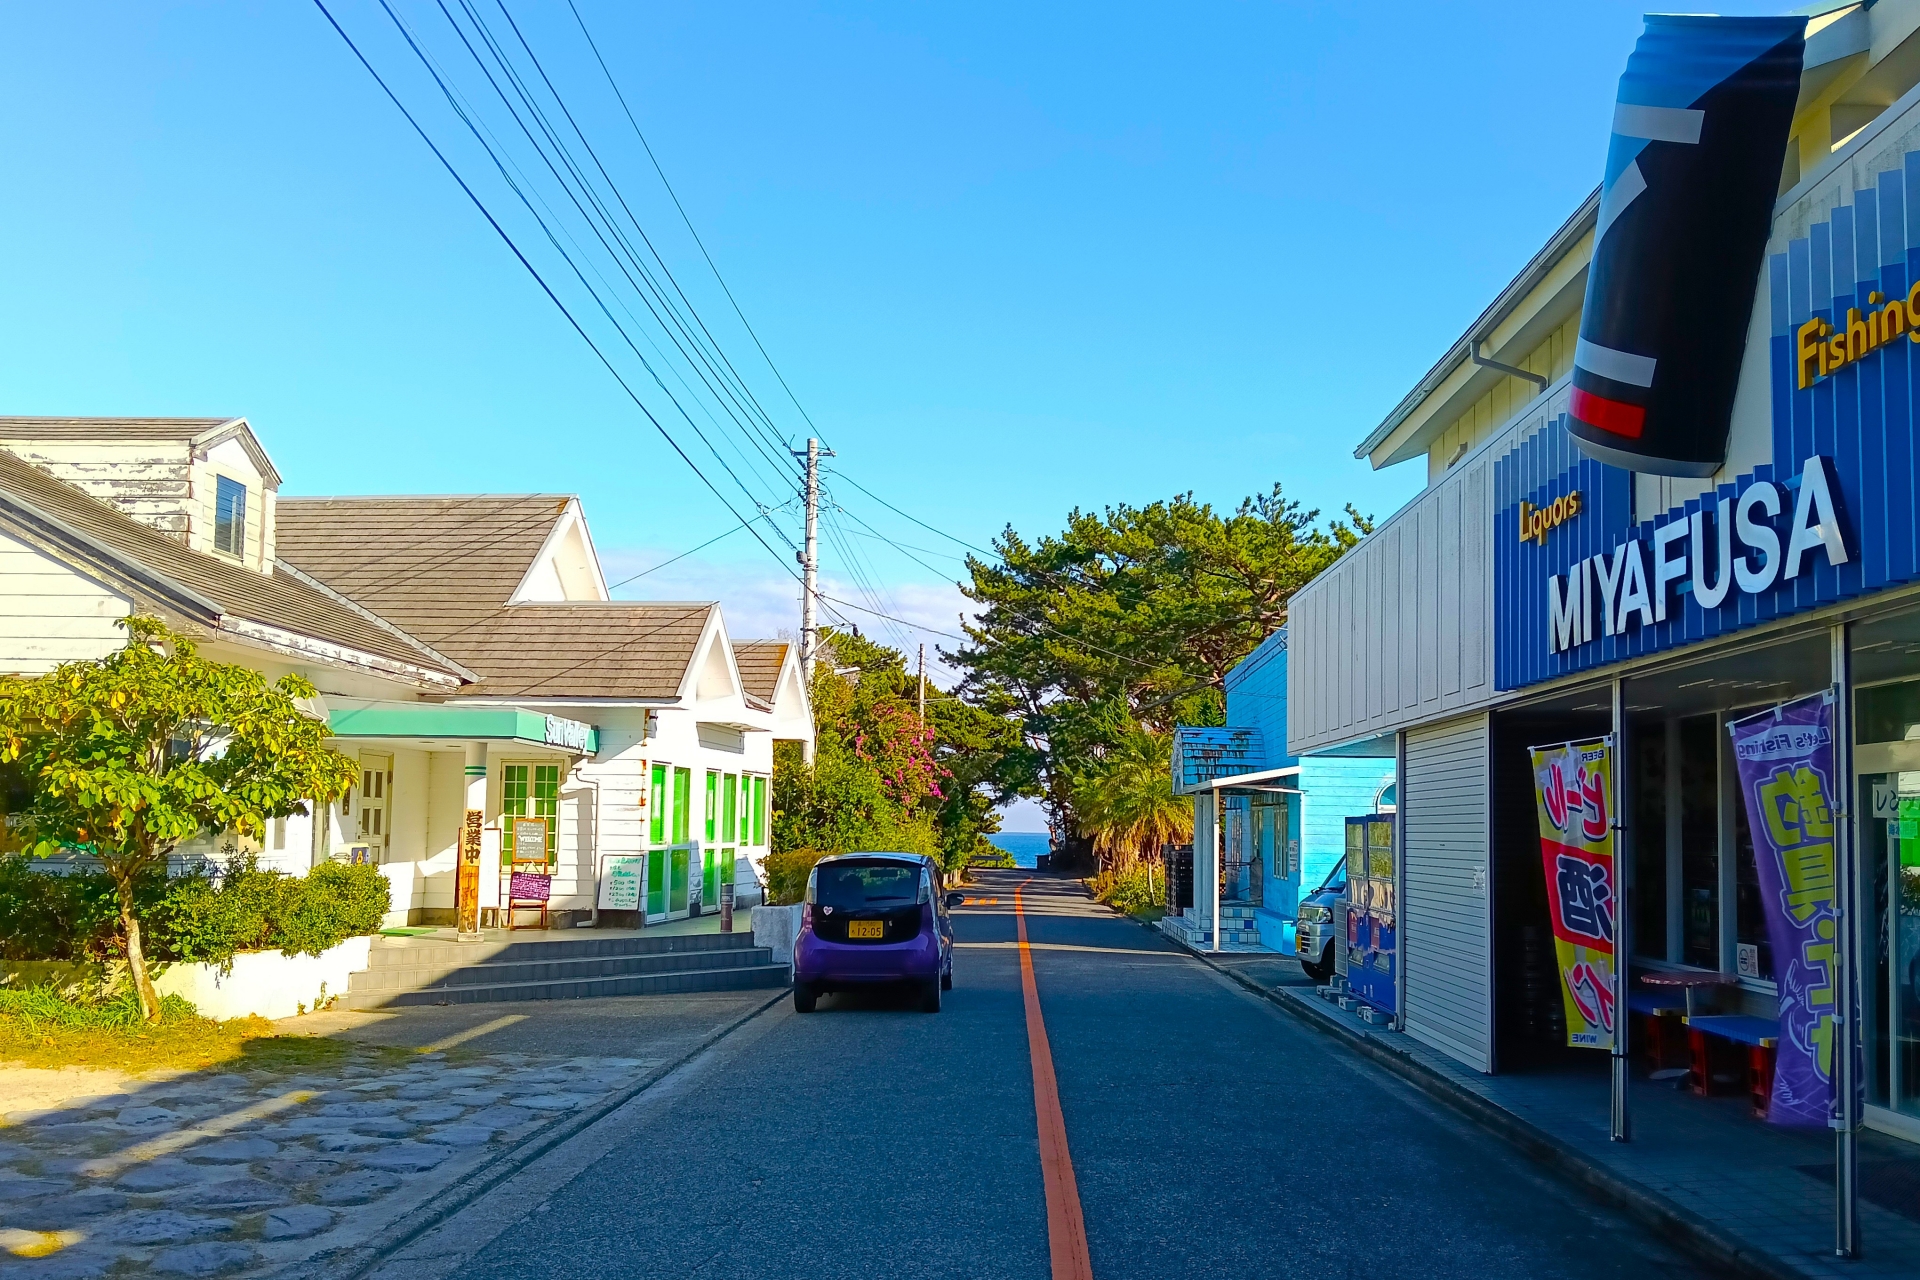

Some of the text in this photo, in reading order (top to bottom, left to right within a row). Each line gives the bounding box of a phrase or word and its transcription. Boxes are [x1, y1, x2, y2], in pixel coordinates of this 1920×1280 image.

[1797, 280, 1920, 390] Fishing
[1519, 489, 1582, 545] Liquors
[1549, 454, 1848, 655] MIYAFUSA
[546, 714, 591, 754] Sun Valley
[465, 811, 483, 864] 営業中
[857, 927, 881, 936] 12-05
